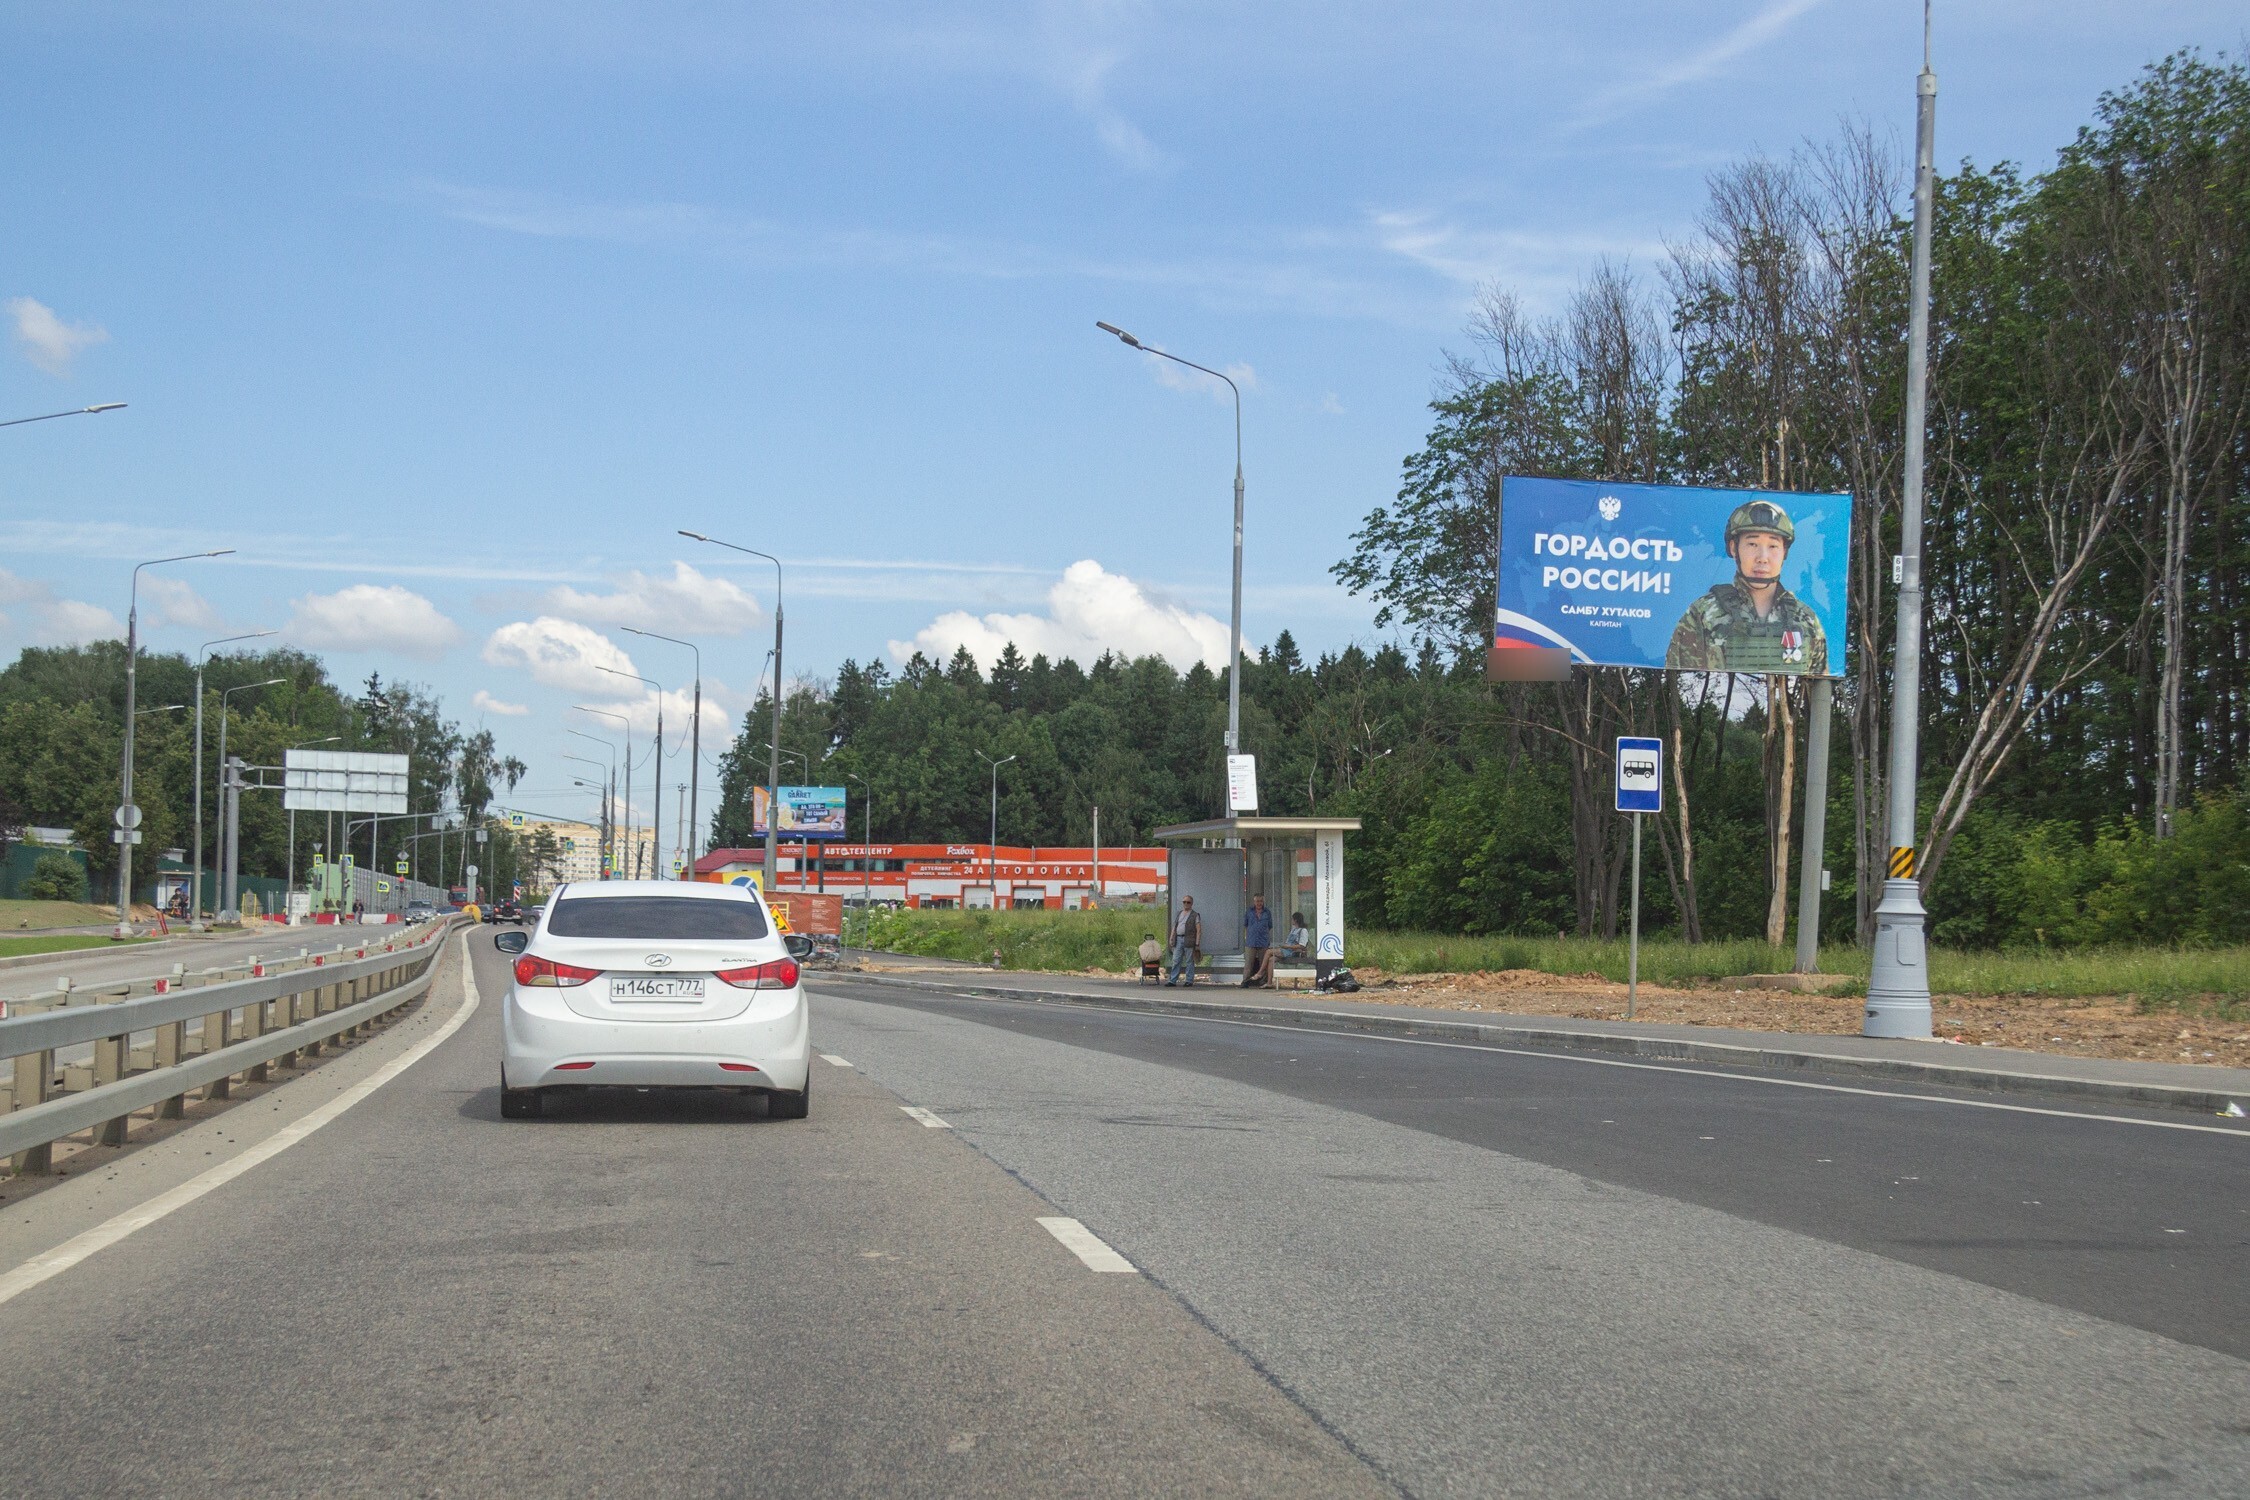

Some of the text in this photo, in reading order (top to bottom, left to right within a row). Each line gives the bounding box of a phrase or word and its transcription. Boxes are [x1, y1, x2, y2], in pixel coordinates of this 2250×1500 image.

[1534, 533, 1683, 562] ГОРДОСТЬ
[1542, 566, 1671, 594] РОССИИ!
[1560, 605, 1651, 618] САМБУ ХУТАКОВ
[1589, 620, 1622, 628] КАПИТАН
[964, 866, 974, 875] 24
[677, 980, 700, 991] 777
